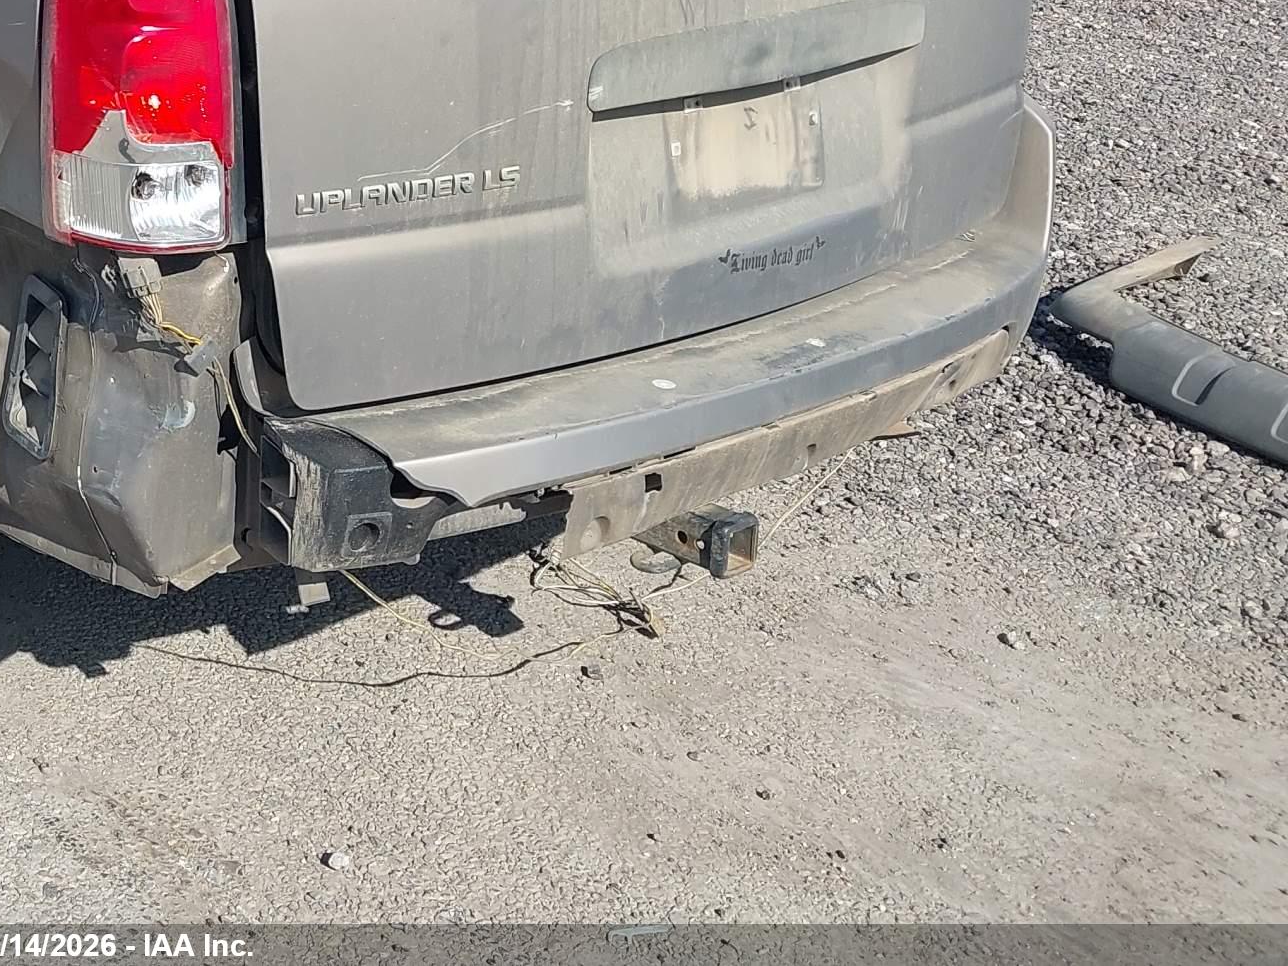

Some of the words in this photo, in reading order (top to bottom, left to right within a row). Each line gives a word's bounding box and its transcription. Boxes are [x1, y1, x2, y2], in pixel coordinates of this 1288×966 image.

[295, 171, 476, 216] UPLANDER
[481, 165, 521, 191] LS
[730, 250, 768, 274] Living
[771, 246, 793, 266] dead
[795, 242, 815, 266] girl
